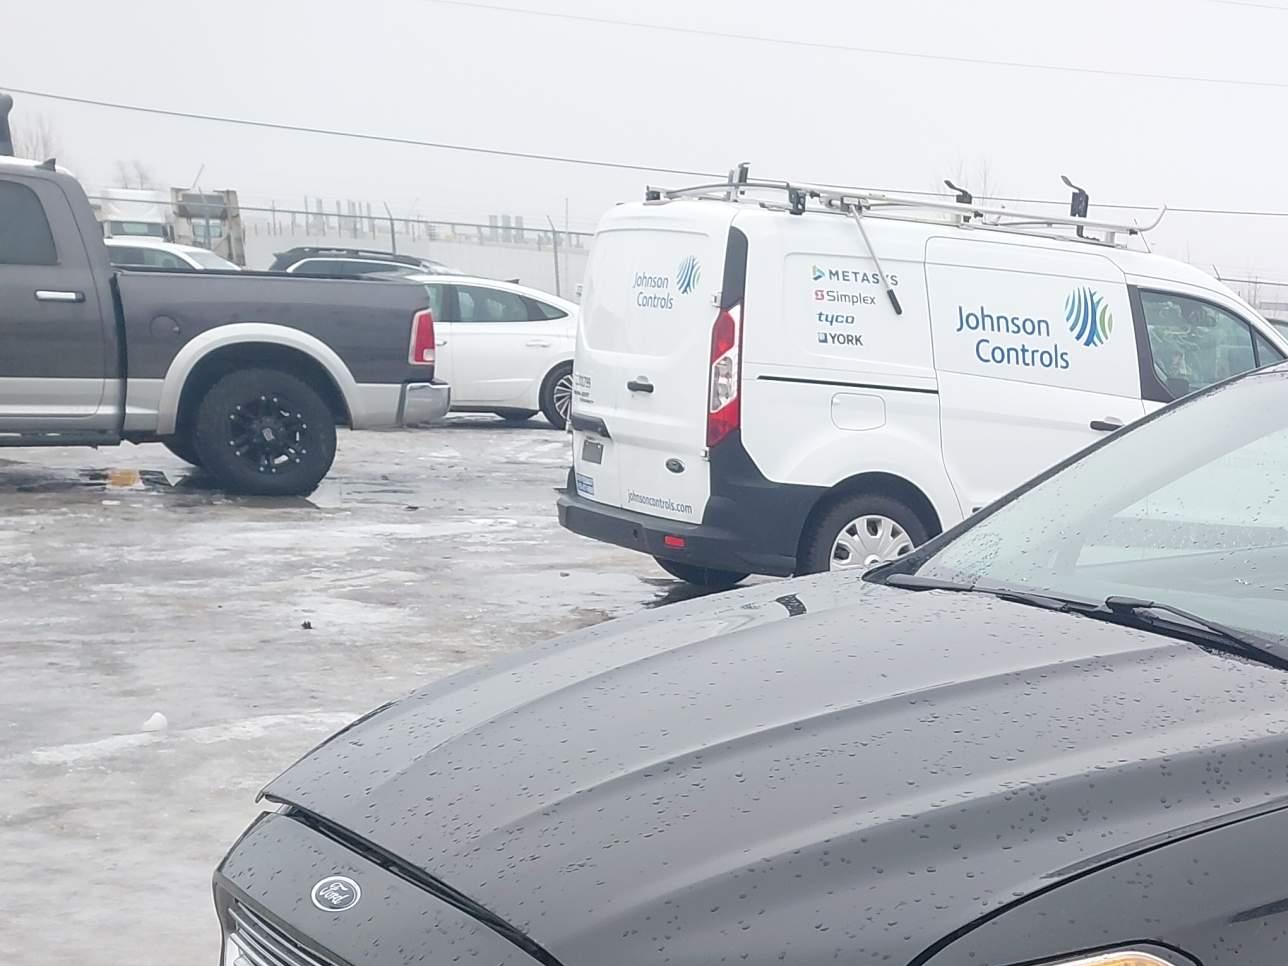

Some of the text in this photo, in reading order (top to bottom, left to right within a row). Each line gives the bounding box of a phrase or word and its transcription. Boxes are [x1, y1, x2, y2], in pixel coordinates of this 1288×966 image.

[632, 271, 669, 289] Johnson
[828, 269, 898, 286] METASS
[637, 291, 673, 309] Controls
[826, 290, 876, 306] Simplex
[816, 311, 855, 326] tyco
[956, 305, 1050, 337] Johnson
[828, 332, 864, 346] YORK
[975, 338, 1070, 369] Controls
[627, 488, 693, 514] johnsoncontrols.com
[319, 882, 350, 905] Ford
